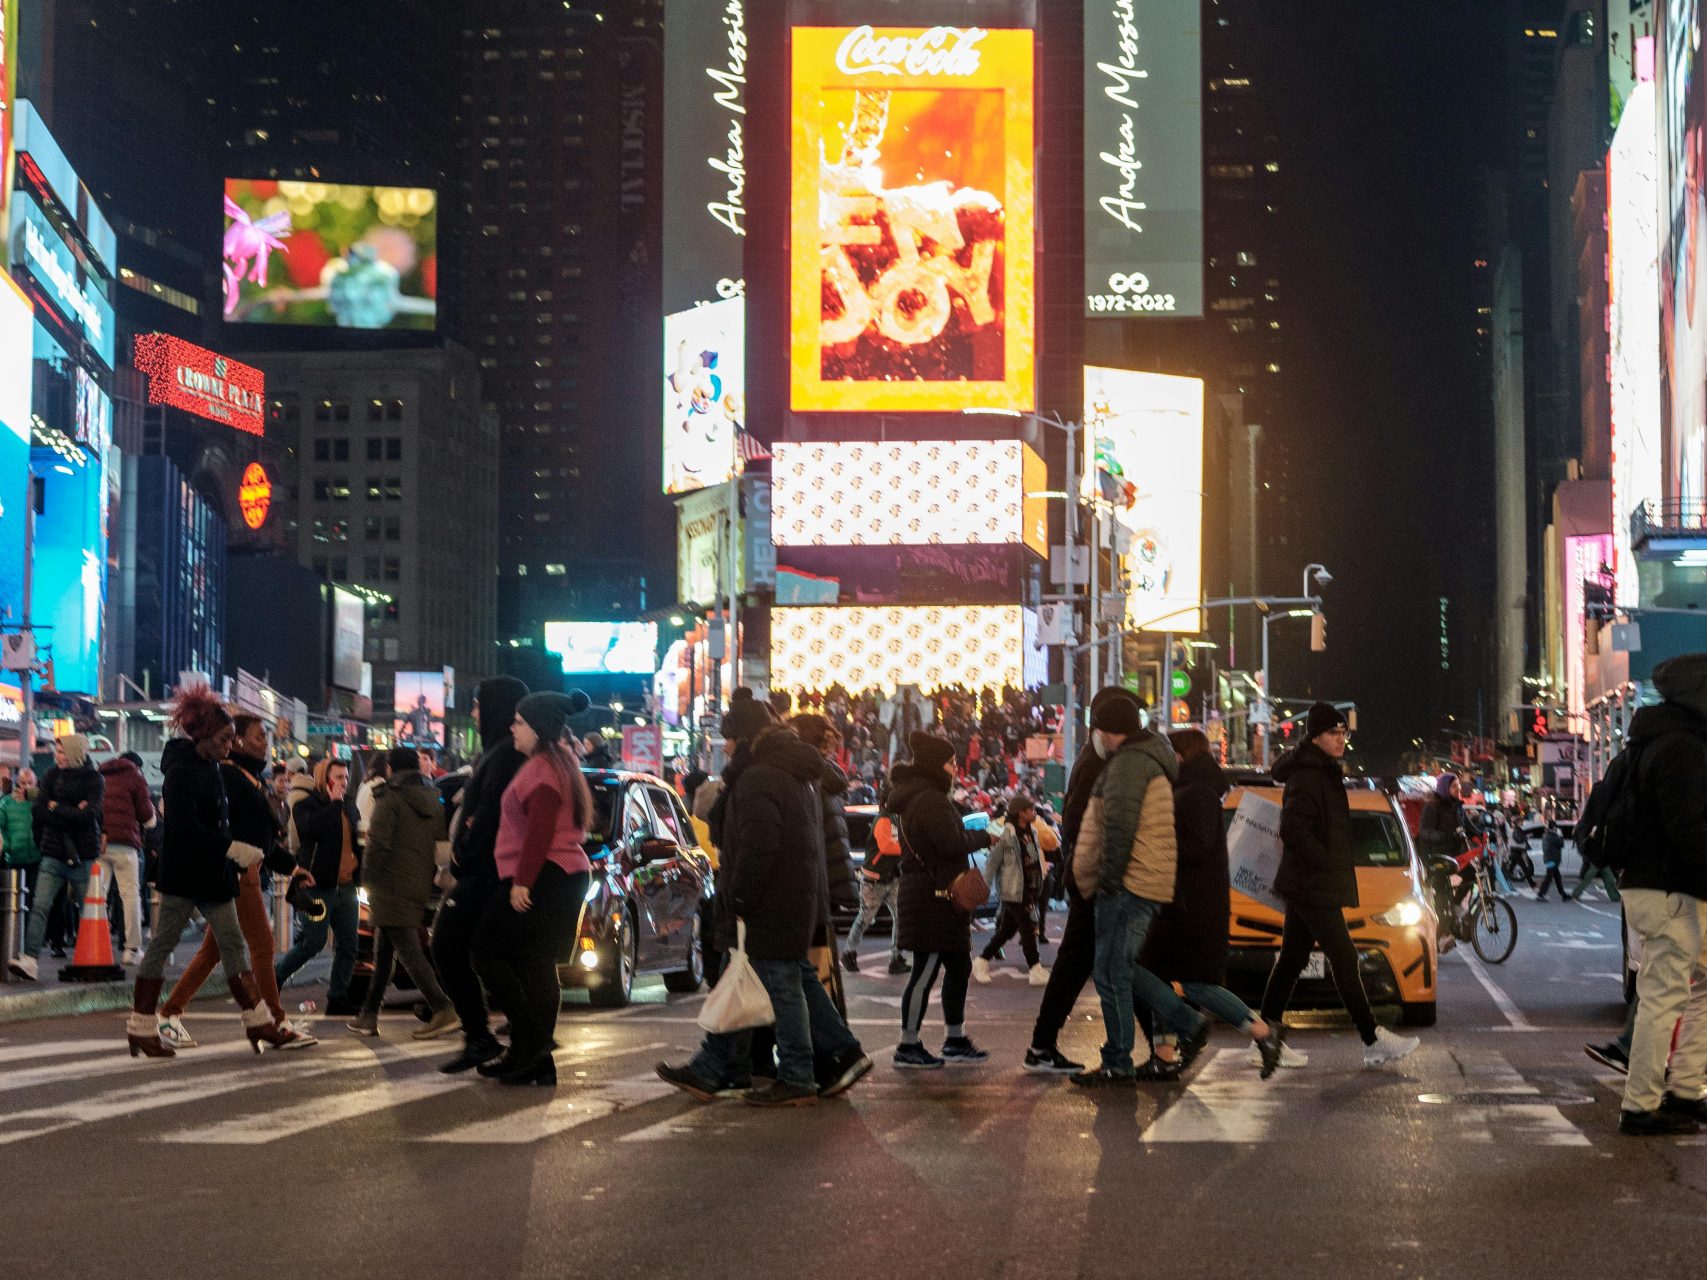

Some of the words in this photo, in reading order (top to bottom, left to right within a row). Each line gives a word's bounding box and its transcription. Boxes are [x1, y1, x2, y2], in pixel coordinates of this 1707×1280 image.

[706, 119, 747, 236] Andrea
[1099, 113, 1147, 233] Andrea
[1087, 294, 1176, 312] 1972-2022
